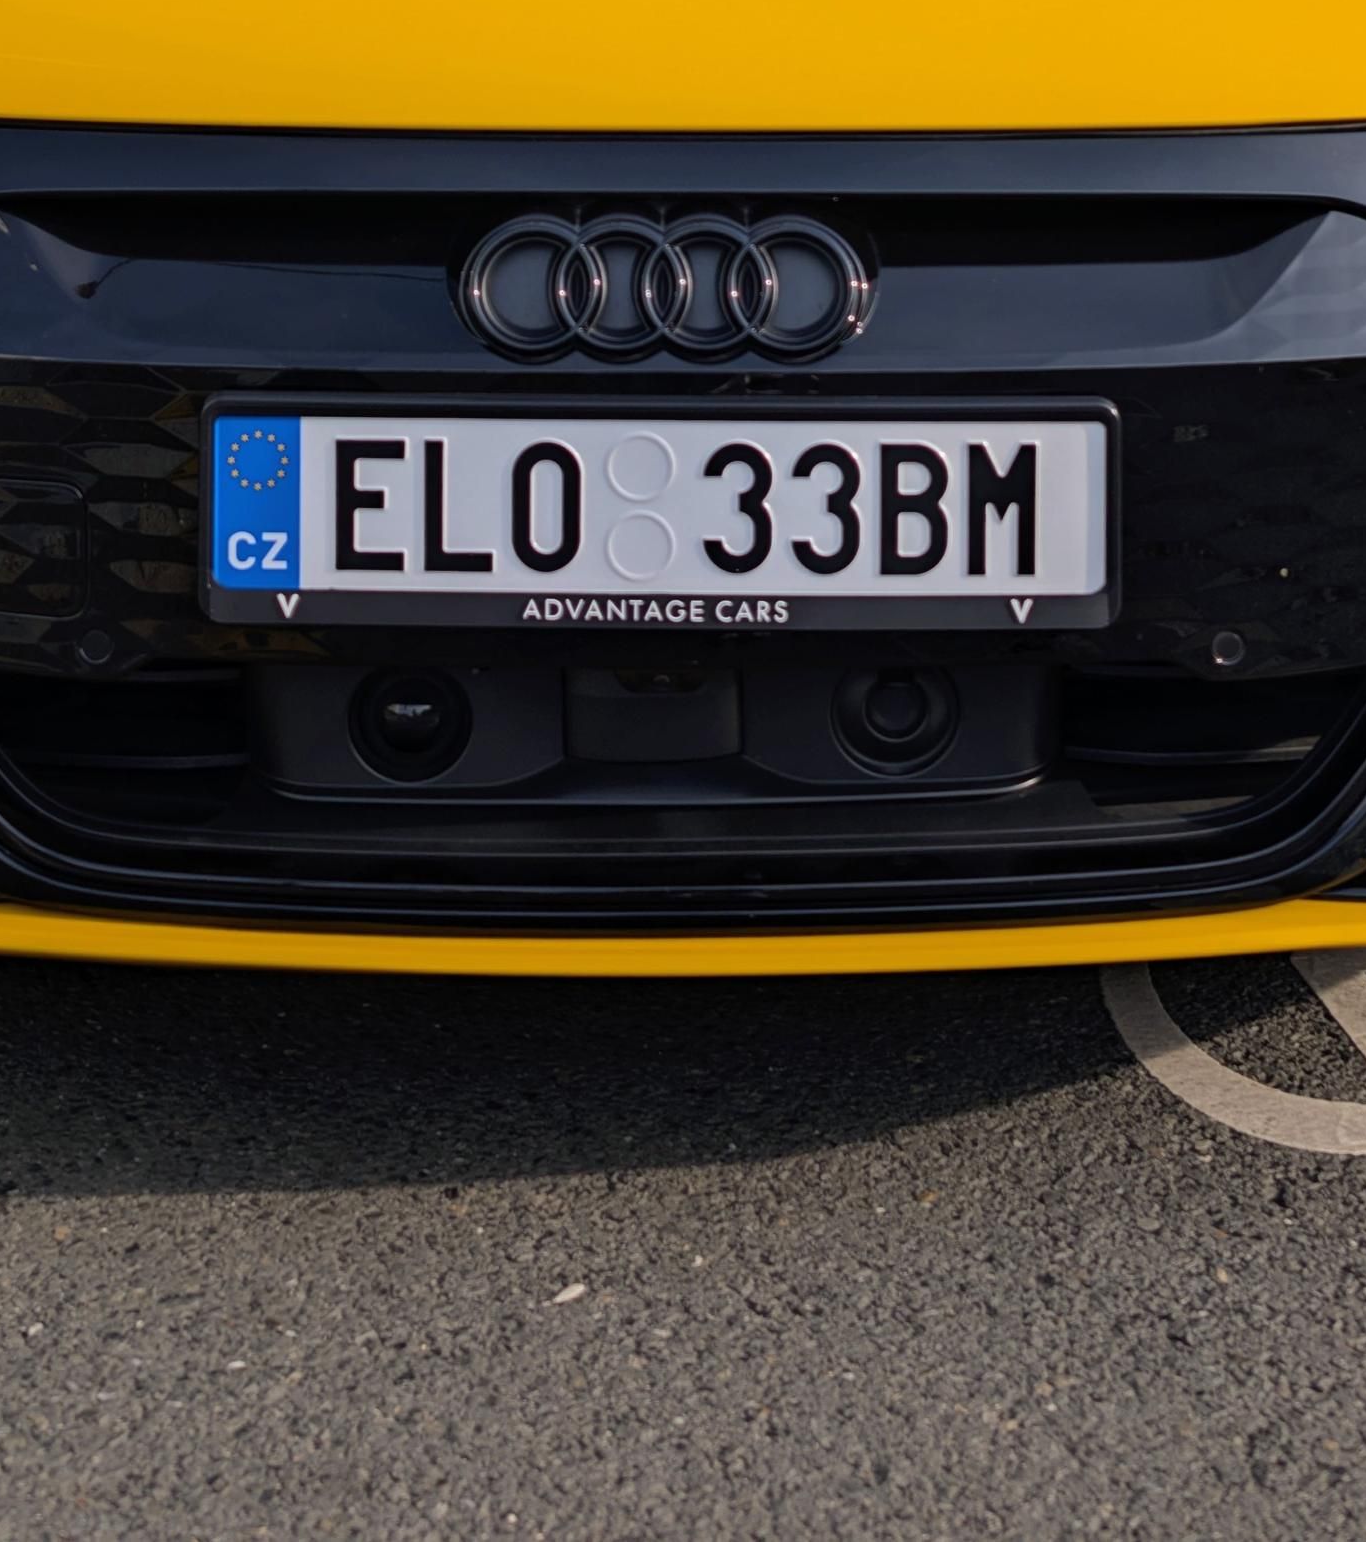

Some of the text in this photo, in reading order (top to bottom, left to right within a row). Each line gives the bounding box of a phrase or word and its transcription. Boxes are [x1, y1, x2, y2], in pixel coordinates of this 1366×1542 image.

[703, 442, 1036, 576] 33BM
[227, 531, 288, 570] CZ
[522, 597, 789, 624] ADVANTAGE CARS
